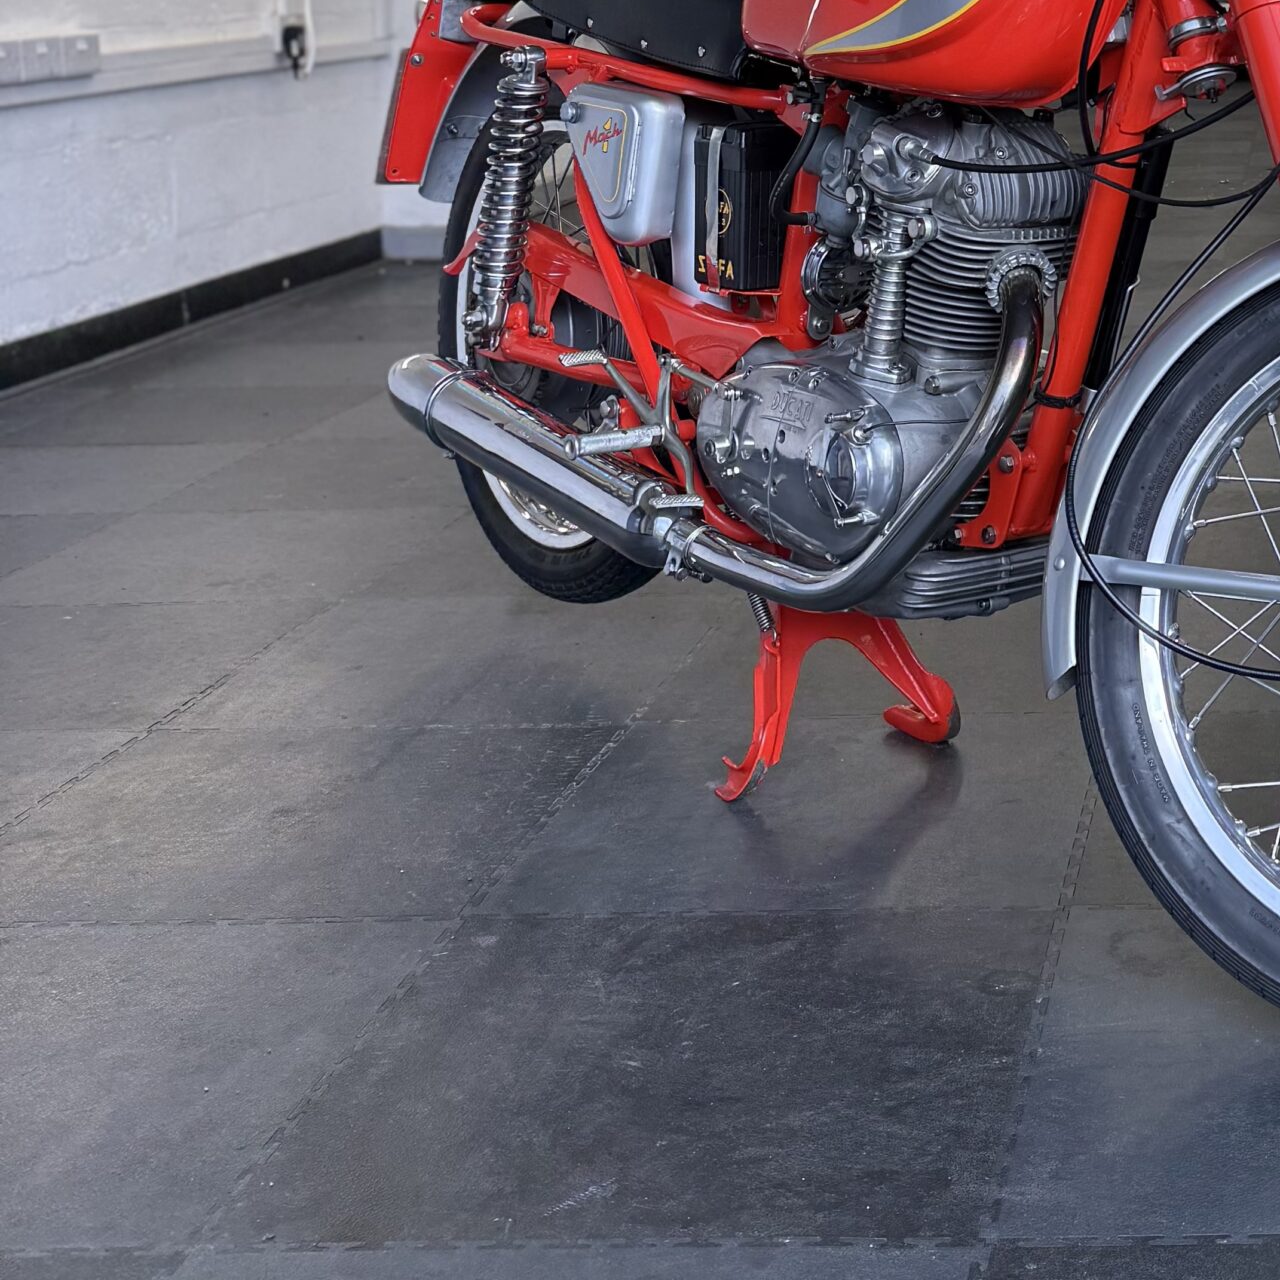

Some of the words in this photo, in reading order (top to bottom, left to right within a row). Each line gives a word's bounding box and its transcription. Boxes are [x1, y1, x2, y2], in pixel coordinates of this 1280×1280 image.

[583, 122, 623, 156] Mach
[770, 390, 814, 422] DUCATI
[1146, 758, 1157, 772] IN
